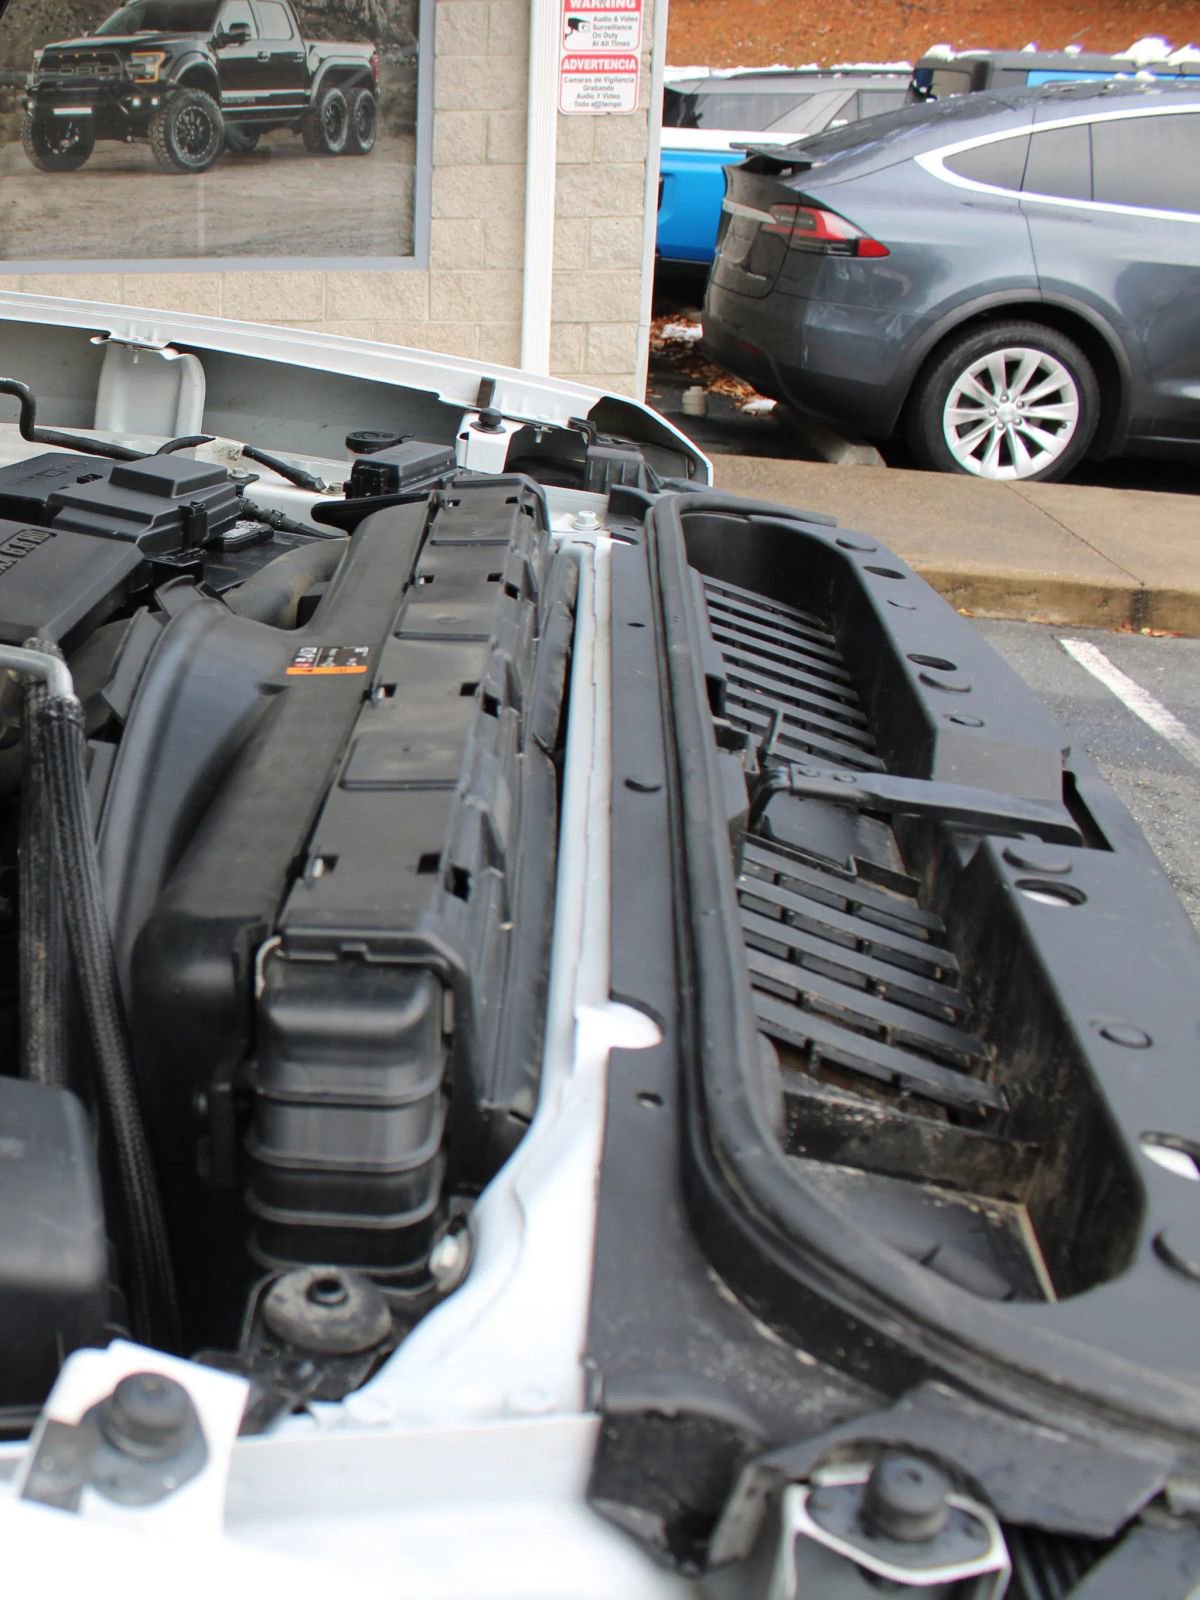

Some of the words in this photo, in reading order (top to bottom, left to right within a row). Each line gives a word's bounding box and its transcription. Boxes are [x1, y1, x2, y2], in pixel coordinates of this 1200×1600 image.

[571, 0, 635, 8] WARNING
[563, 58, 636, 69] ADVERTENCIA
[0, 537, 36, 559] 6.6
